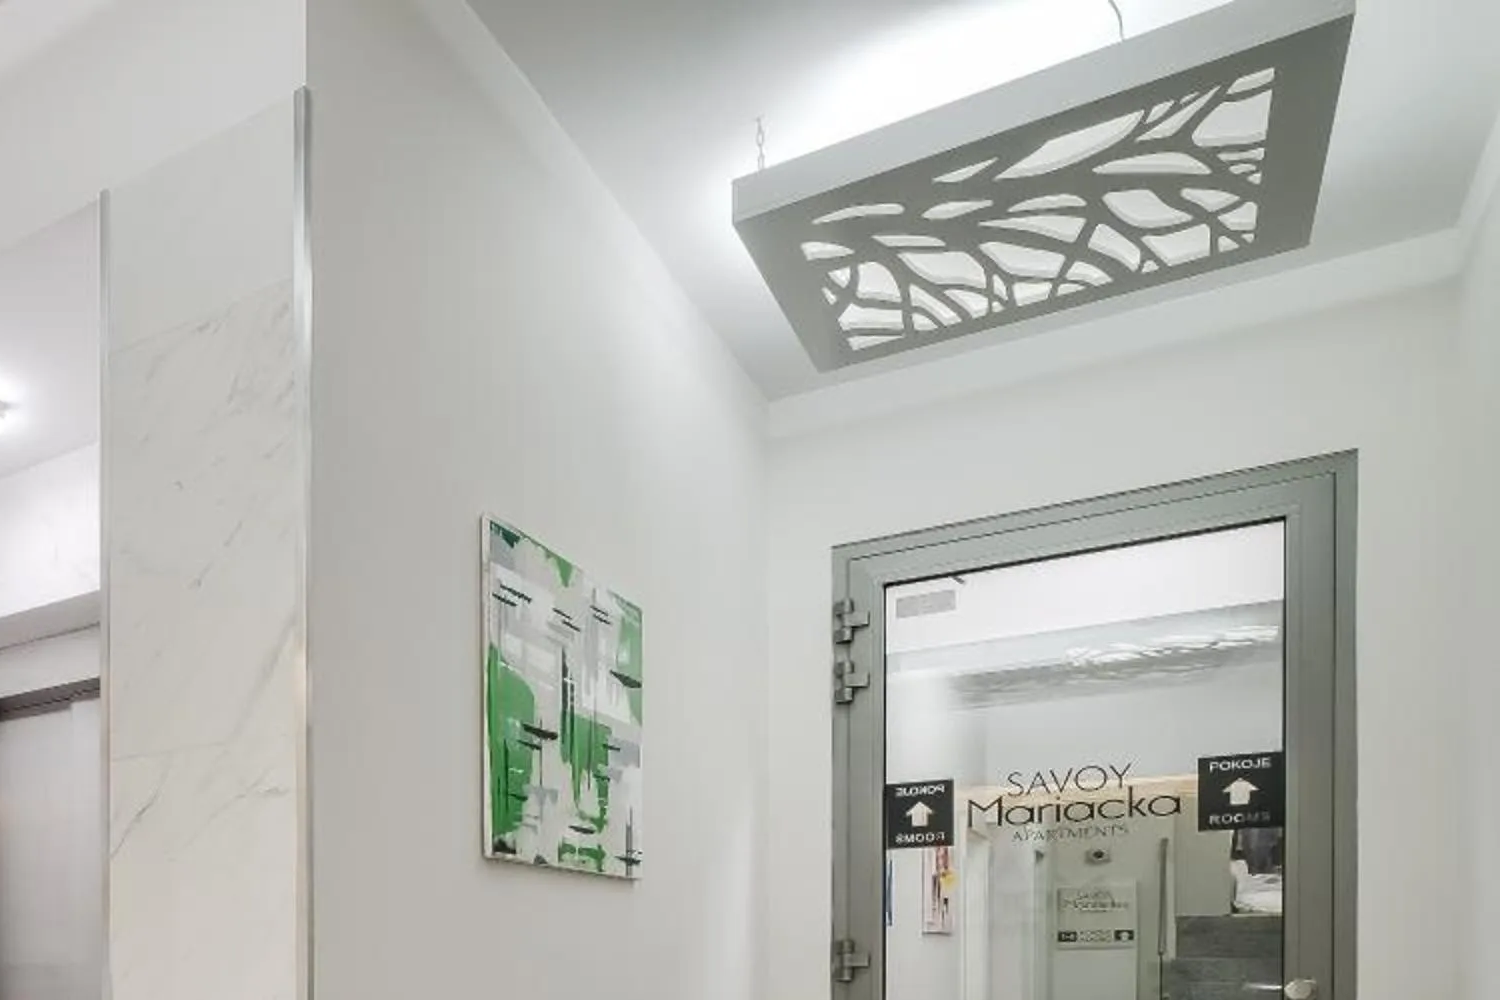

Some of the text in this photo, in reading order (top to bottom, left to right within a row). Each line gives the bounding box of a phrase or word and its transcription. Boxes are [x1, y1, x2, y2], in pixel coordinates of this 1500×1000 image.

[1208, 756, 1272, 773] POKOJE
[1007, 763, 1132, 797] SAVOY
[967, 785, 1182, 829] Mariacka
[1209, 811, 1271, 825] ROOMS
[1013, 823, 1130, 843] APARTMENTS
